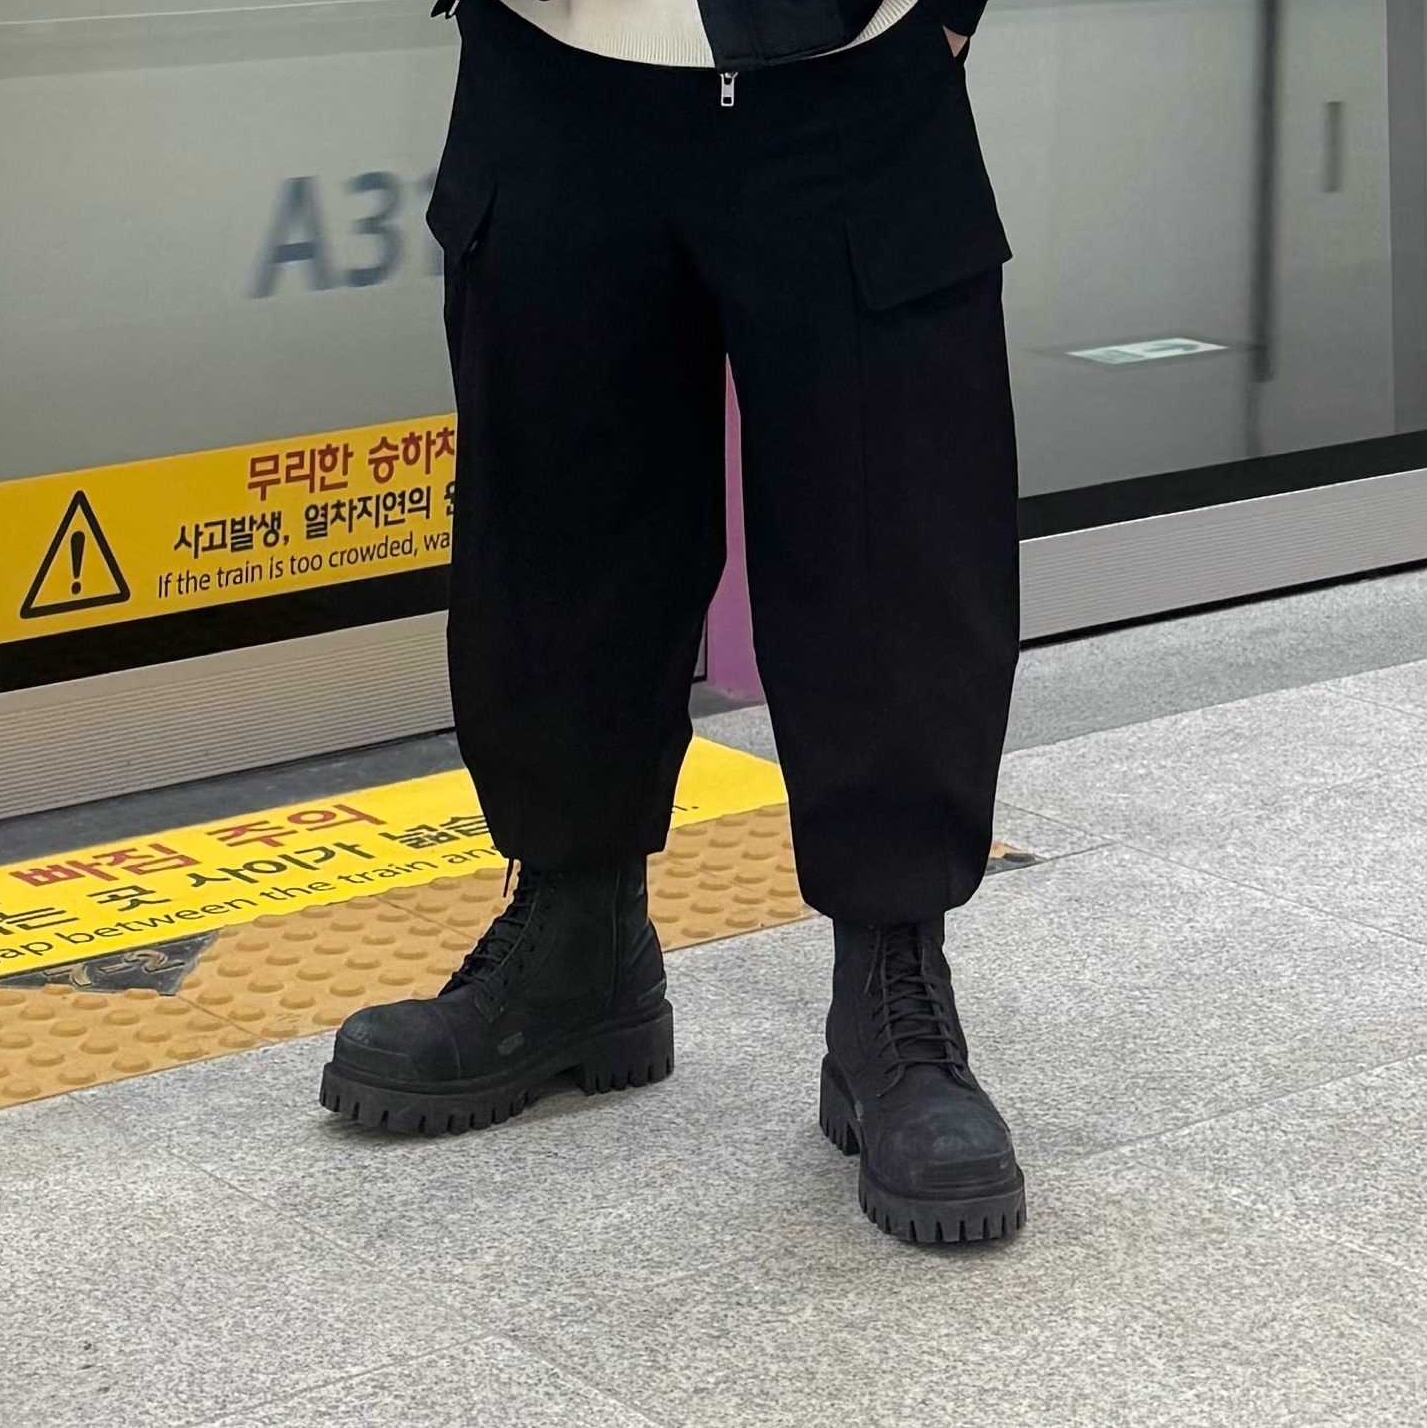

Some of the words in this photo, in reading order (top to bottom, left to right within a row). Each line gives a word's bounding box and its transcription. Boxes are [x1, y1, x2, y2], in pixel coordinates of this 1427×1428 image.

[244, 171, 444, 300] A3
[247, 443, 354, 501] 무리한
[173, 511, 290, 559] 사고발생,
[305, 485, 432, 540] 열차지연의
[158, 572, 172, 598] If
[176, 570, 210, 596] the
[217, 560, 262, 589] train
[269, 555, 283, 580] is
[290, 553, 322, 575] too
[329, 531, 418, 569] crowded,
[8, 843, 201, 887] 빠짐
[205, 803, 387, 848] 주의
[87, 884, 172, 912] 곳
[186, 841, 375, 888] 사이가
[55, 897, 259, 947] between
[259, 880, 337, 904] the
[337, 858, 439, 887] train
